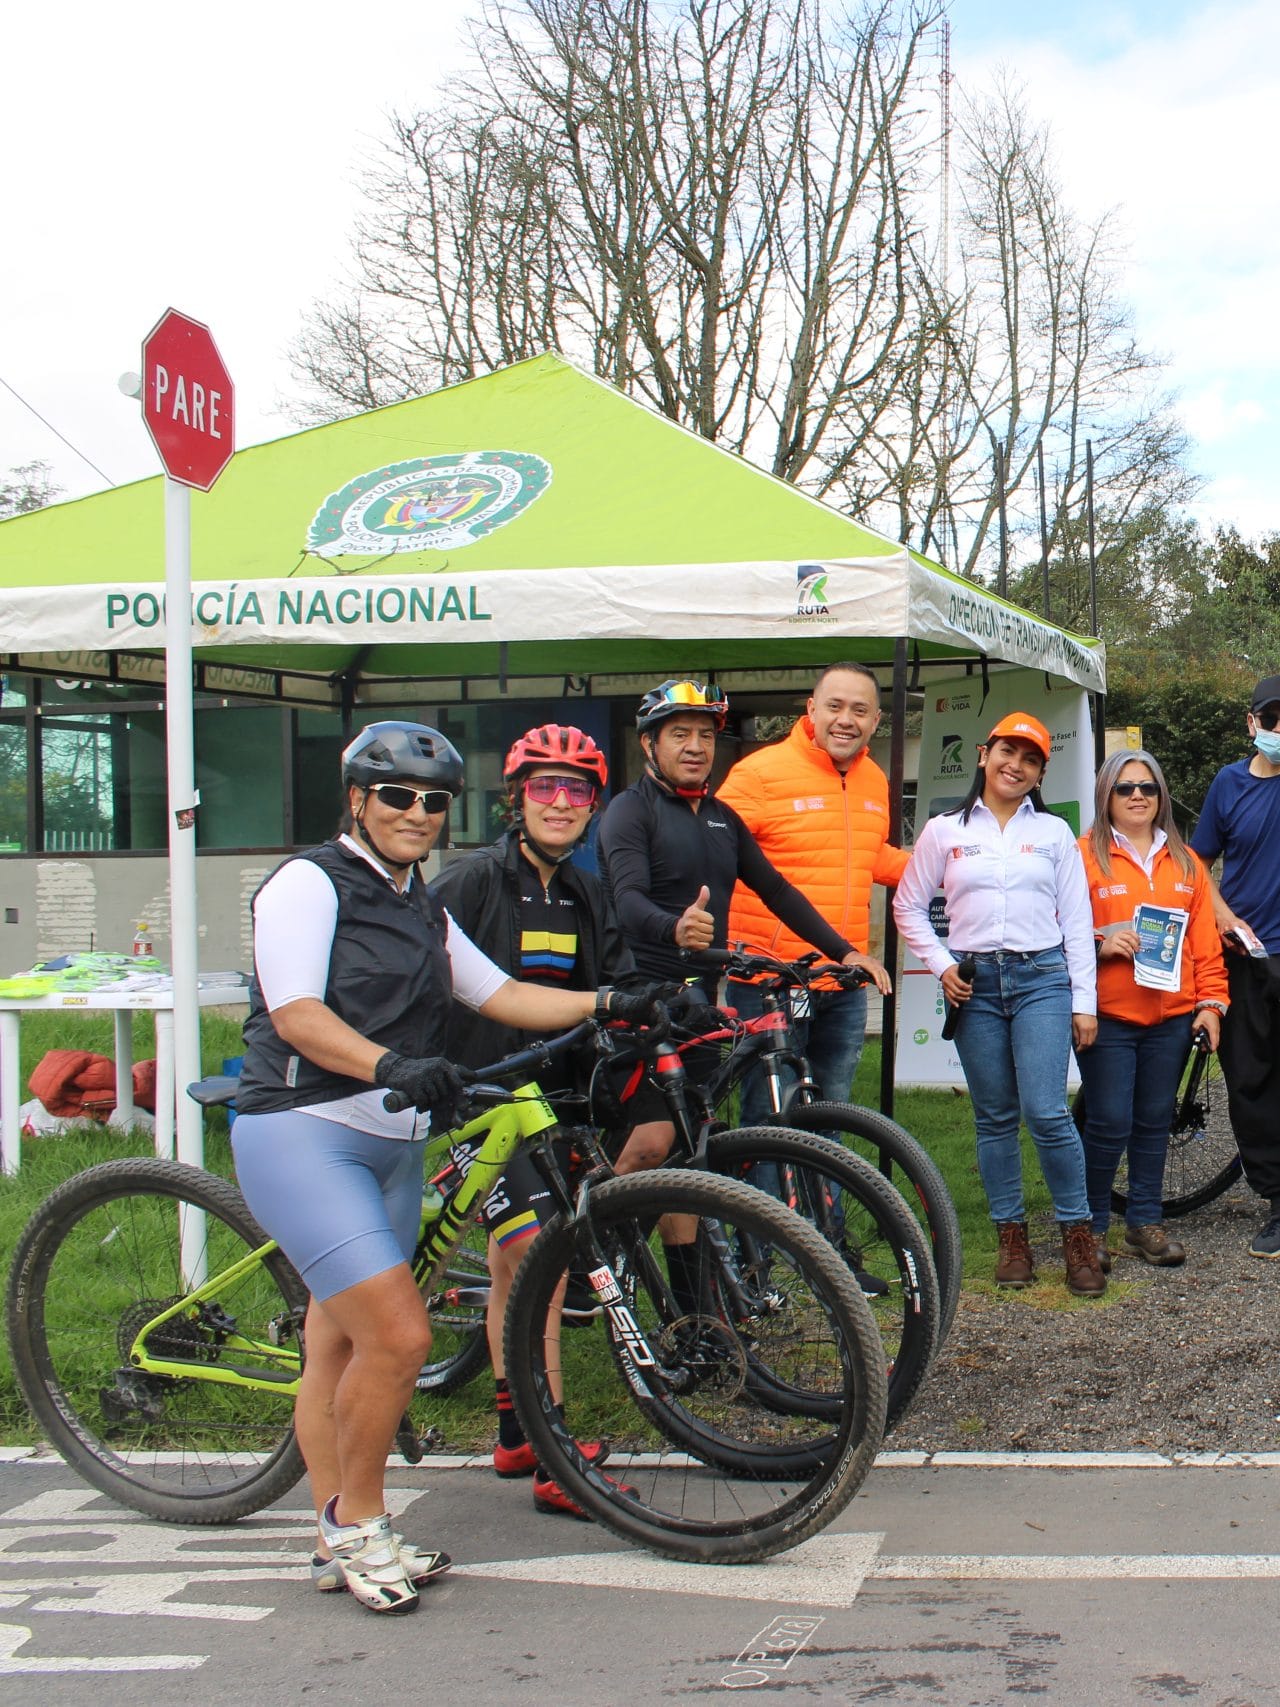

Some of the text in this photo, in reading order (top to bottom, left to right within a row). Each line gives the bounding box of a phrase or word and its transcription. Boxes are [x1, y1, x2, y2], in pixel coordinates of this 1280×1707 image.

[154, 364, 222, 439] PARE
[452, 465, 476, 474] DE
[407, 508, 496, 542] NACIONAL
[107, 583, 493, 629] POCÍA NACIONAL
[797, 605, 829, 615] RUTA
[951, 703, 971, 711] VIDA
[1056, 731, 1071, 740] Fase
[1048, 744, 1064, 752] ctor
[940, 764, 963, 774] RUTA
[964, 849, 982, 857] VIDA
[1111, 887, 1128, 895] VIDA
[16, 1242, 39, 1313] FAST TRAK
[592, 1269, 613, 1290] OCK
[607, 1305, 656, 1366] SID
[44, 1379, 135, 1476] BONTRAGER
[810, 1444, 854, 1514] FAST TRAK
